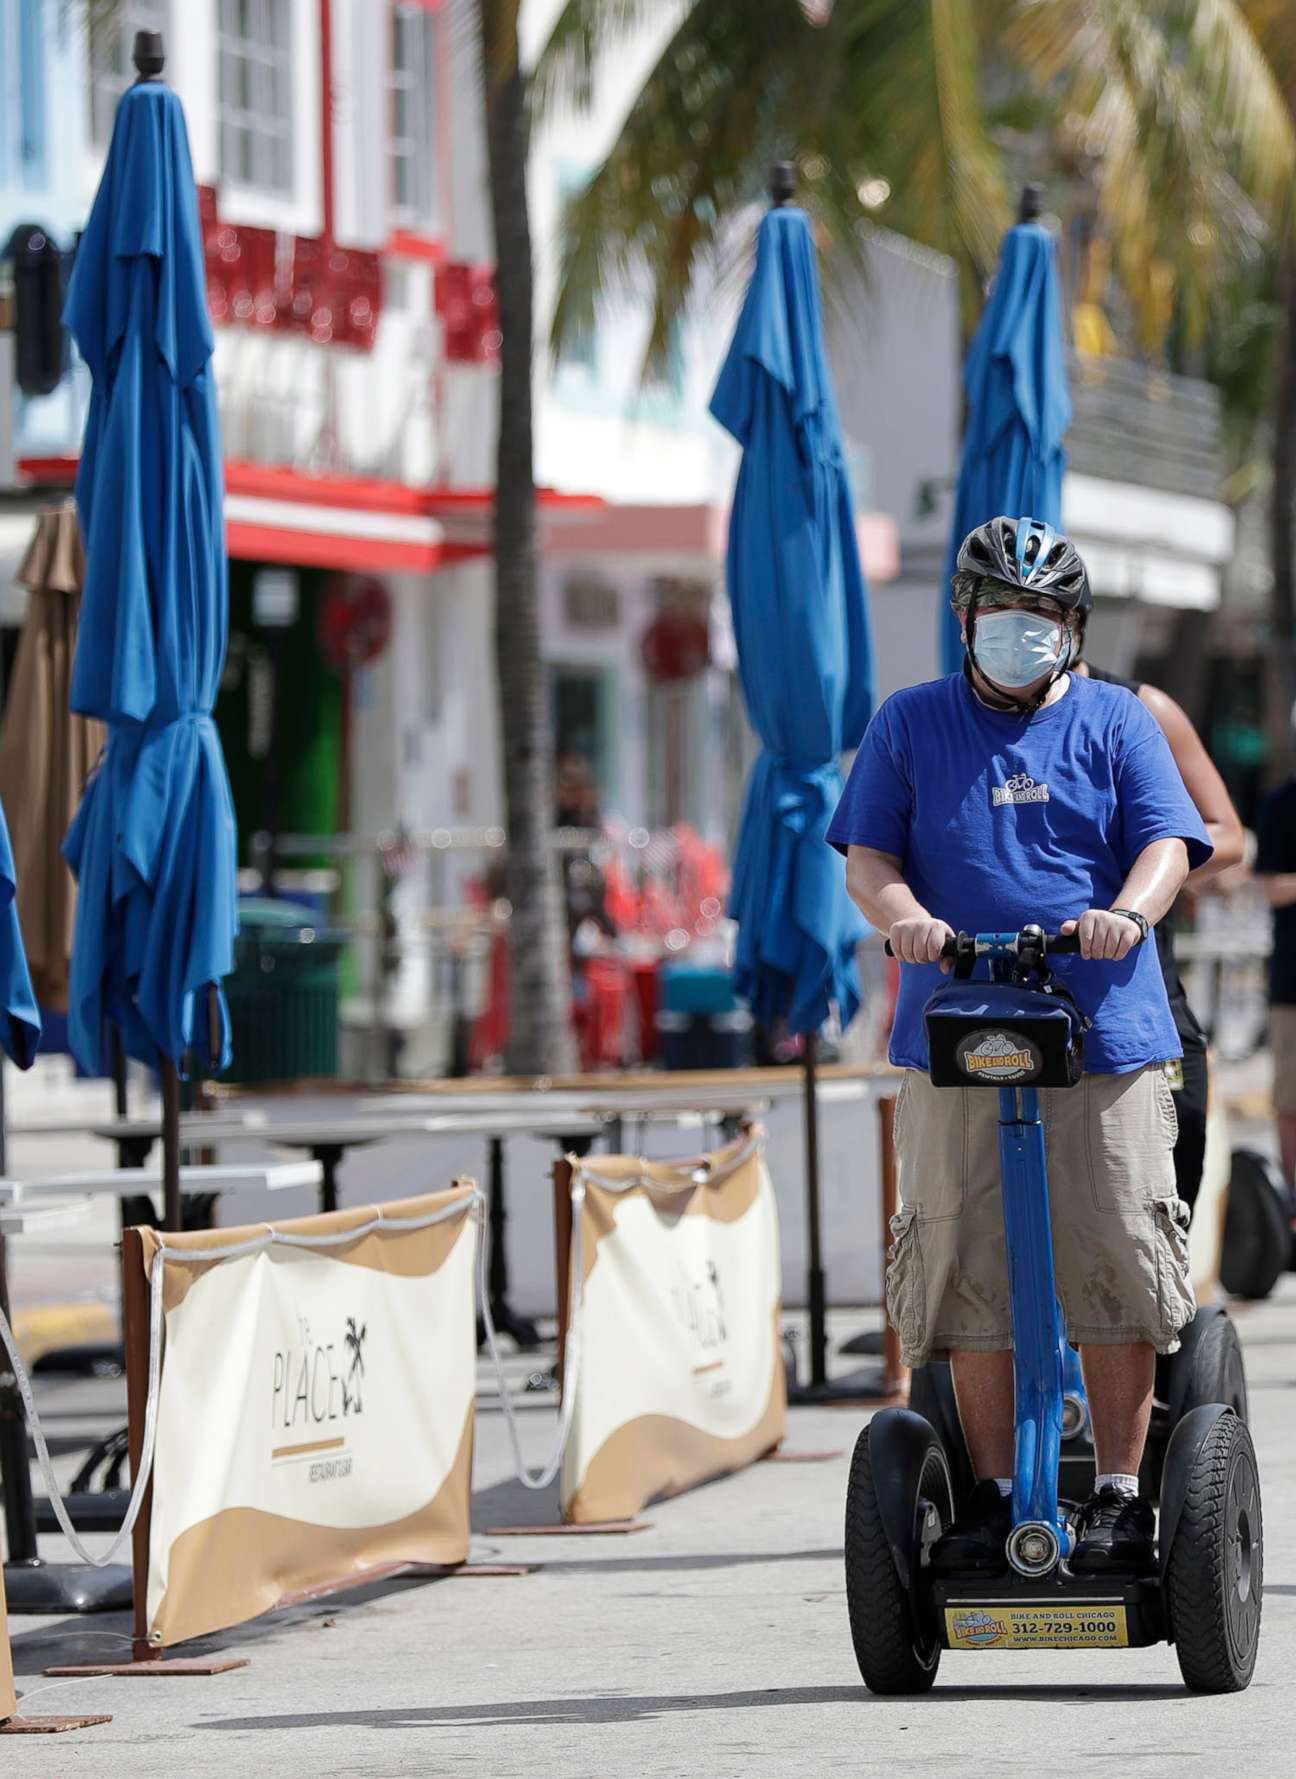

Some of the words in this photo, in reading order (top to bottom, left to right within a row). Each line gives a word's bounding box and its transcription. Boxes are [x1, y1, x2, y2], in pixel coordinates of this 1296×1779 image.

[1026, 784, 1048, 801] ROLL
[967, 1055, 992, 1069] BIKE
[1004, 1052, 1031, 1068] ROLL
[271, 1344, 338, 1429] PLACE
[1033, 1612, 1052, 1620] AND
[1076, 1611, 1115, 1619] CHICAGO
[985, 1620, 1008, 1635] ROLL
[1012, 1621, 1116, 1634] 312-729-1000
[1013, 1634, 1117, 1643] WWW.BIKECHICAGO.COM
